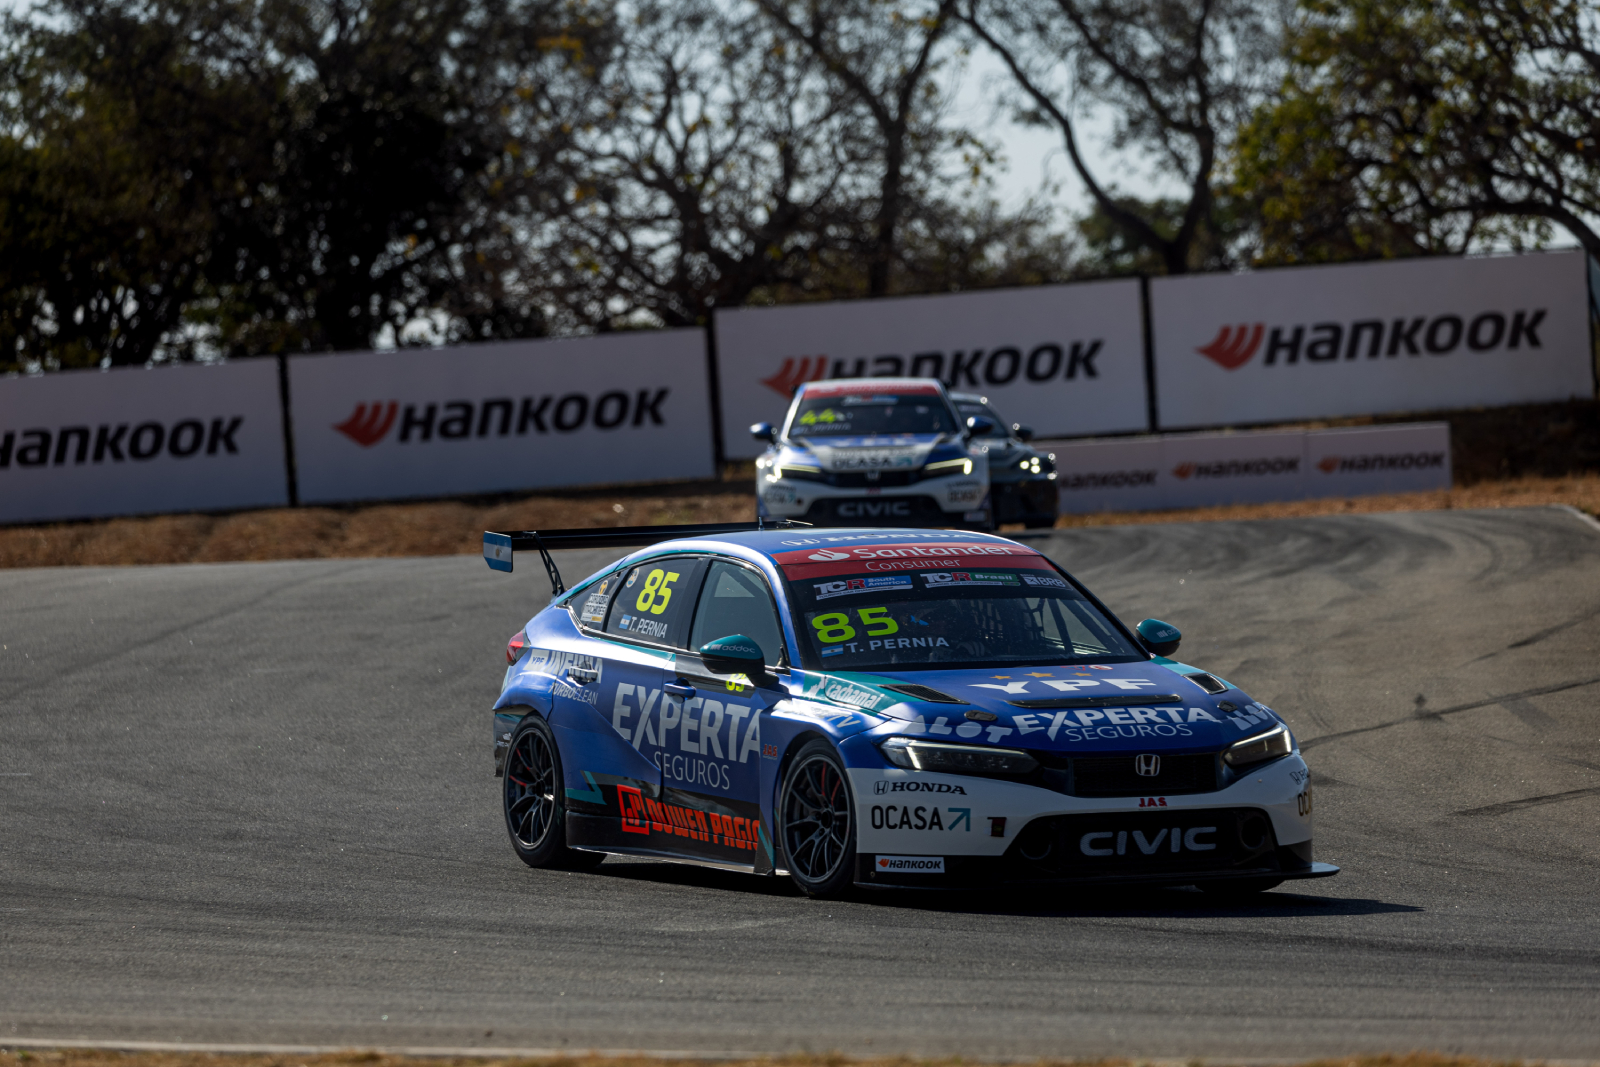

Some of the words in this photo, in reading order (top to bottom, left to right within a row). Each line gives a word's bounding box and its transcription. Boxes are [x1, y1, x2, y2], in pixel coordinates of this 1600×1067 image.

[1263, 308, 1548, 367] HANKOOK
[398, 386, 670, 443] HANKOOK
[837, 502, 911, 517] CIVIC
[821, 532, 981, 542] HONDA
[852, 544, 1012, 559] Santander
[865, 558, 961, 572] Consumer
[920, 572, 971, 583] TCR
[636, 569, 680, 614] 85
[813, 578, 865, 595] TCR
[637, 618, 668, 638] PERNIA
[811, 606, 899, 643] 85
[722, 645, 755, 654] addoc
[846, 642, 864, 654] T.
[869, 637, 949, 651] PERNIA
[826, 680, 885, 709] cachamai
[967, 678, 1157, 695] YPF
[612, 682, 761, 764] EXPERTA
[1012, 707, 1222, 742] EXPERTA
[1065, 724, 1193, 742] SEGUROS
[763, 744, 777, 757] JAS
[653, 751, 730, 790] SEGUROS
[891, 781, 967, 796] HONDA
[1139, 797, 1167, 807] JAS
[871, 805, 944, 831] OCASA
[1080, 826, 1218, 857] CIVIC
[887, 860, 942, 871] HANKOOK
